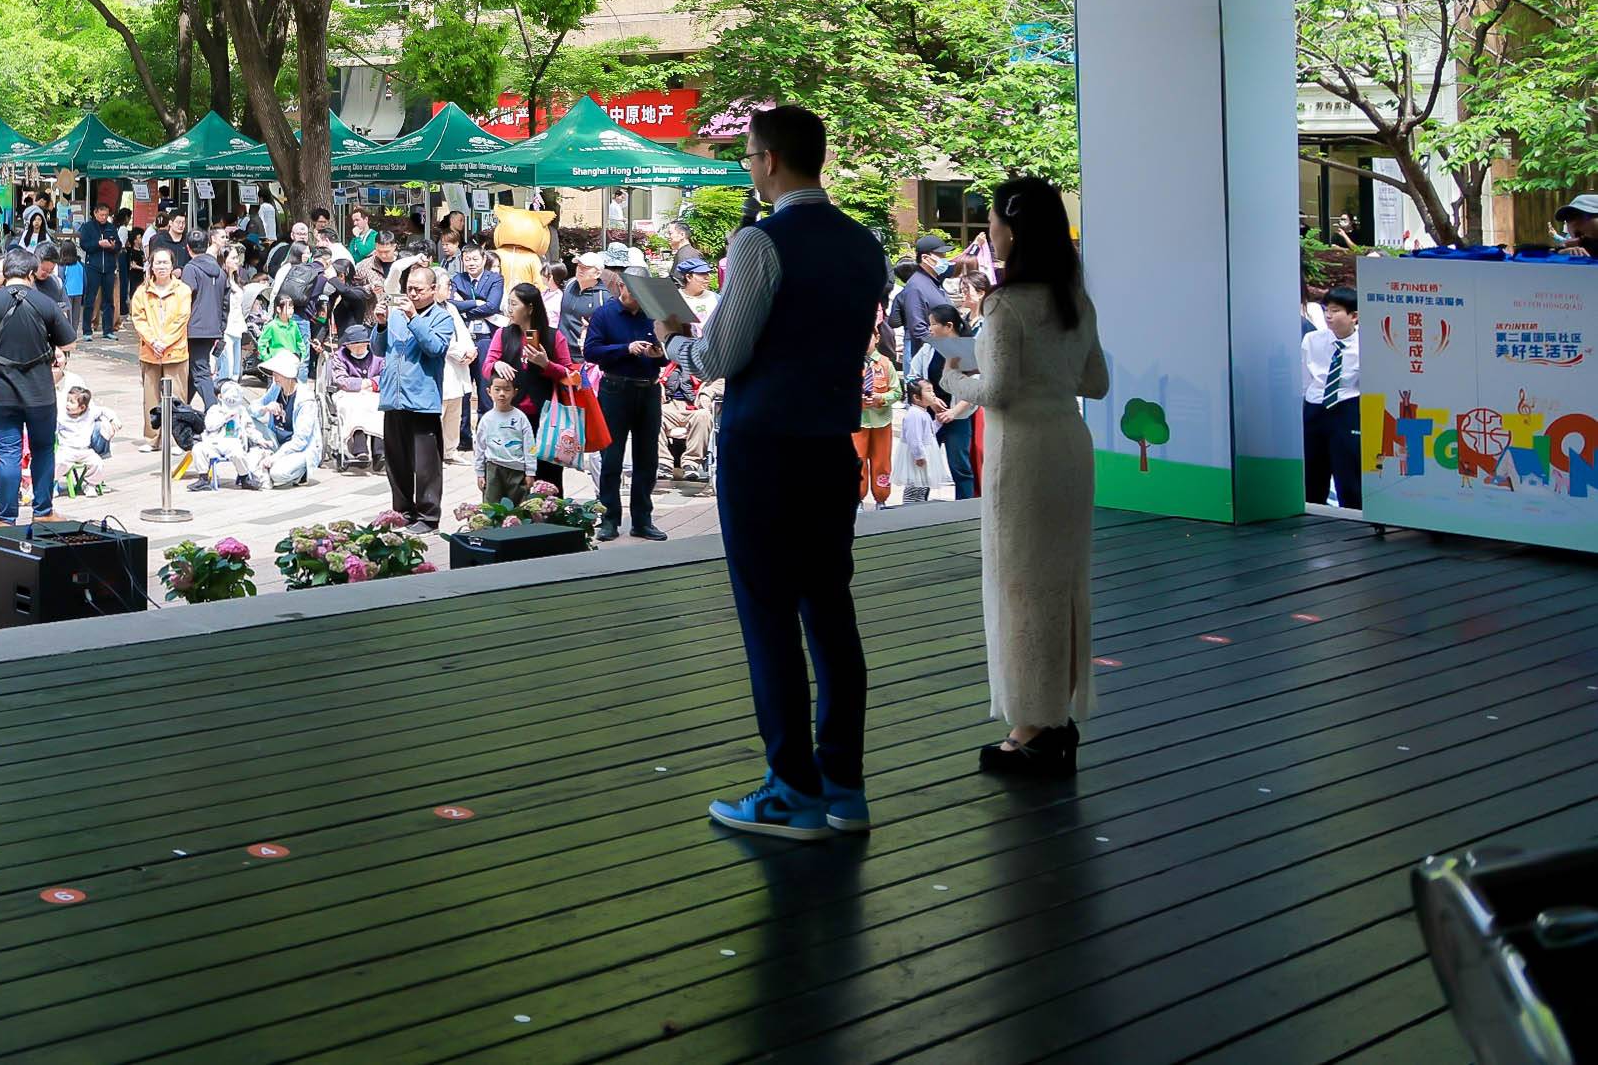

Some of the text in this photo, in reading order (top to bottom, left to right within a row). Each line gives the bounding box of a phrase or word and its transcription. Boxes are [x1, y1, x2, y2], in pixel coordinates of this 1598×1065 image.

[572, 166, 727, 176] Shanghai Hong Qiao International School
[1407, 312, 1424, 374] 联盟成立
[1496, 344, 1579, 360] 美好生活节
